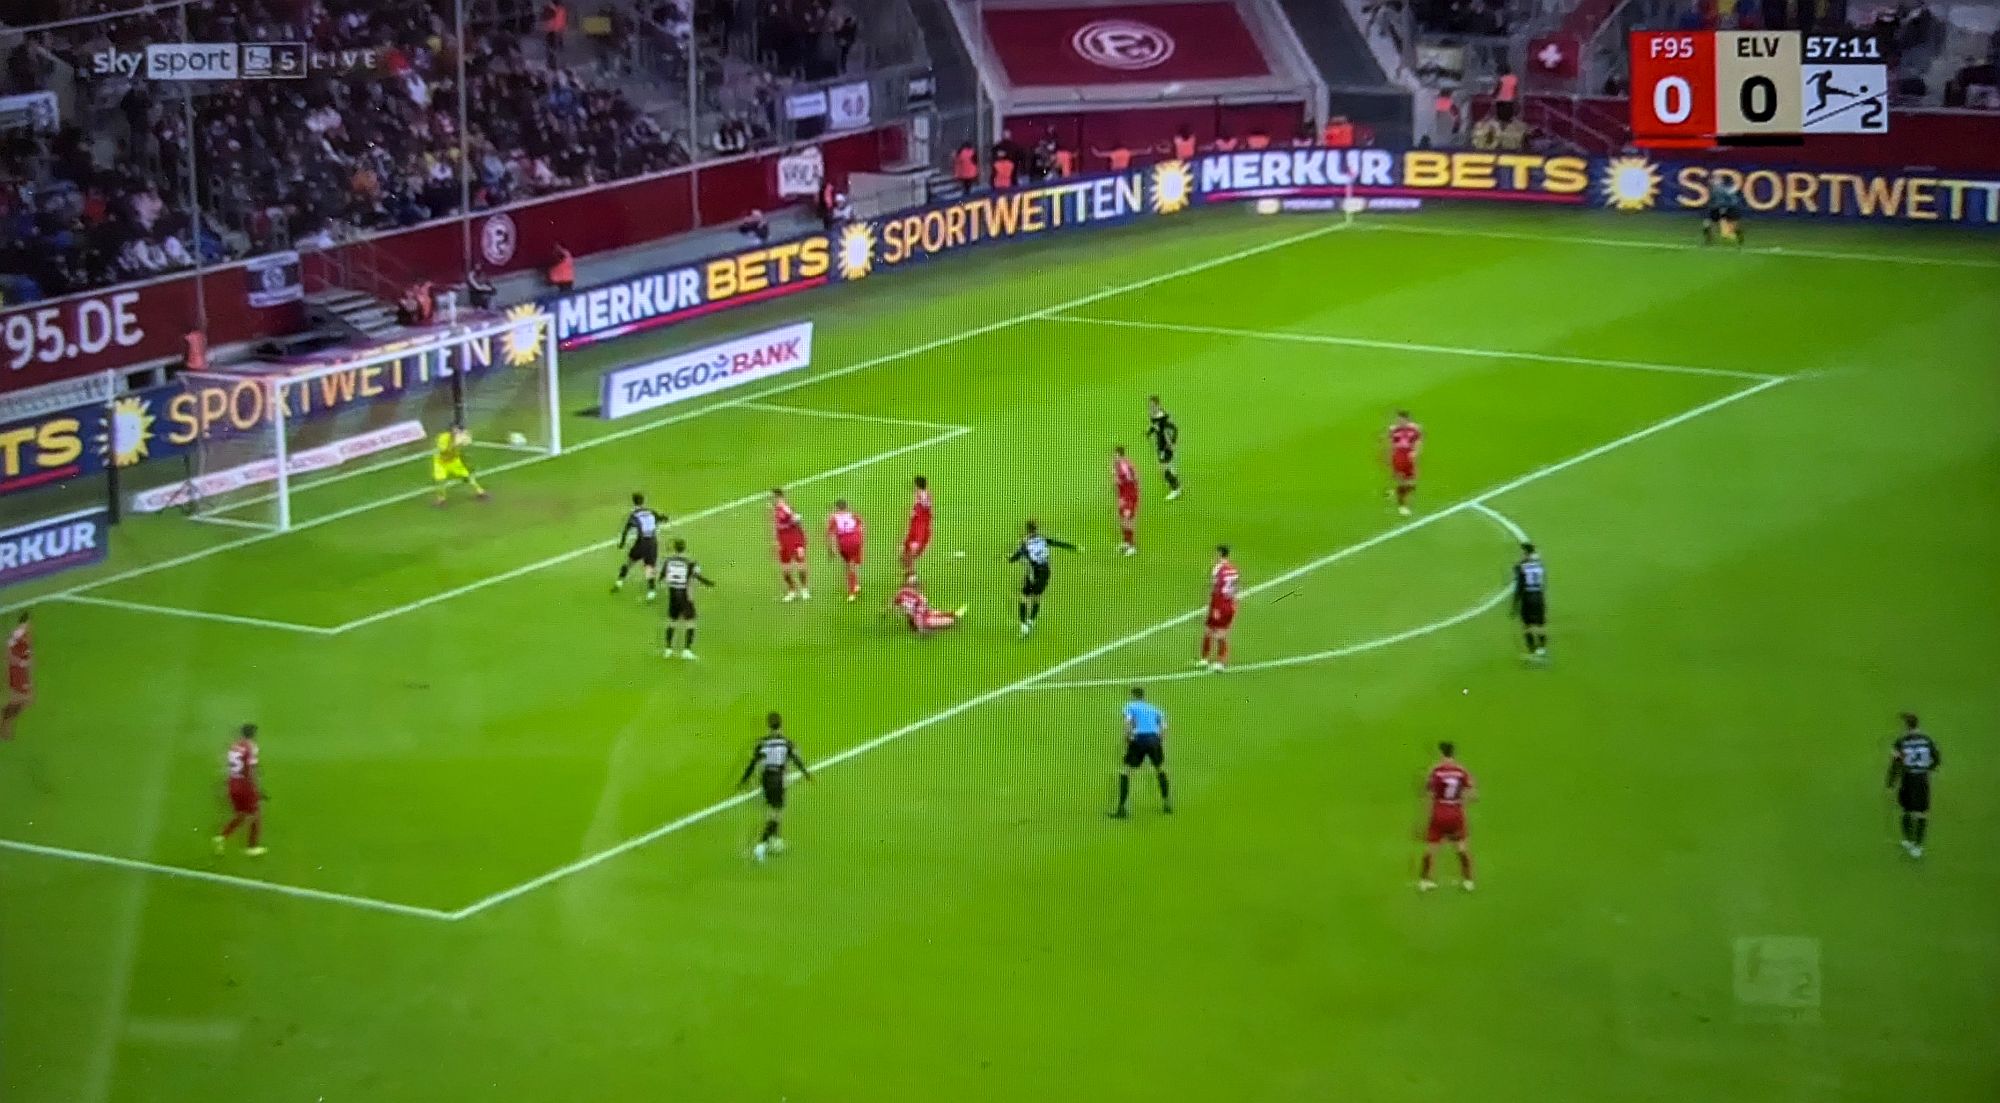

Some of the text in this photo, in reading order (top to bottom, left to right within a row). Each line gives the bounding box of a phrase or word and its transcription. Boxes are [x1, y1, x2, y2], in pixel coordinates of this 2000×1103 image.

[93, 47, 378, 78] sky sport 5 LIVE
[1650, 37, 1693, 59] F95
[1736, 37, 1780, 58] ELV
[1805, 37, 1881, 59] 57:11
[1653, 75, 1693, 125] 0
[1739, 74, 1778, 123] 0
[1200, 149, 1590, 194] MERKUR BETS
[883, 173, 1142, 264] SPORTWETTEN
[558, 235, 831, 339] MERKUR BETS
[0, 291, 145, 370] 95.DE
